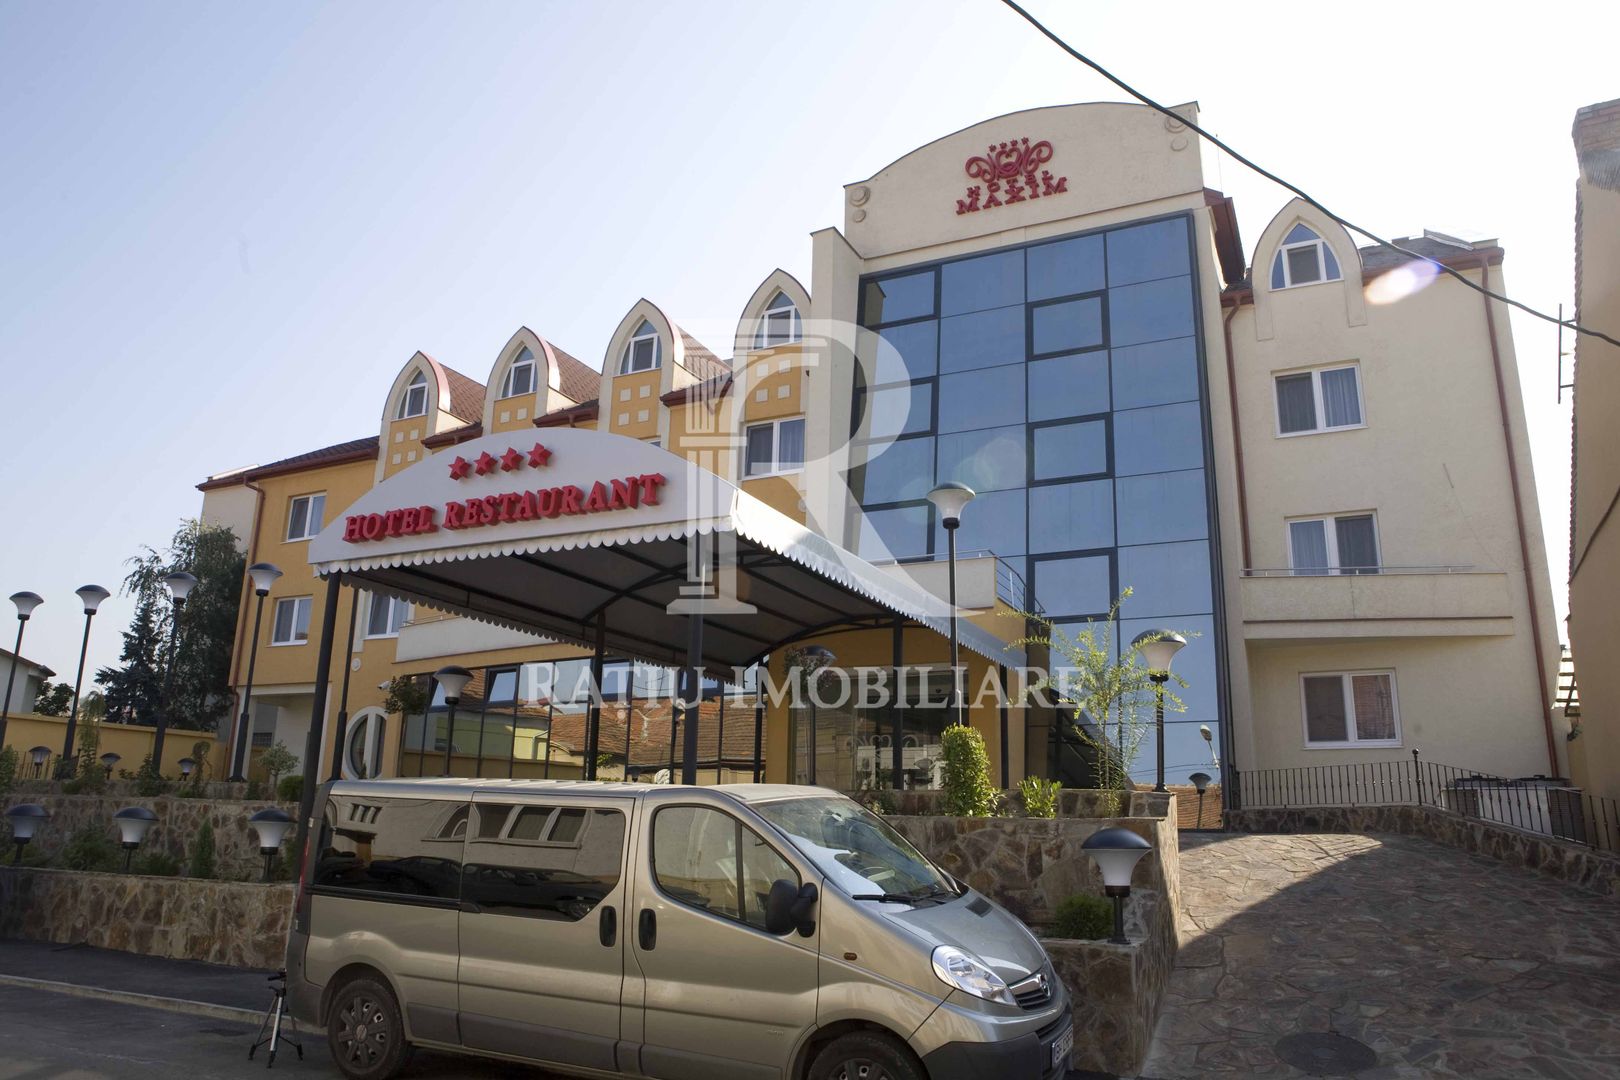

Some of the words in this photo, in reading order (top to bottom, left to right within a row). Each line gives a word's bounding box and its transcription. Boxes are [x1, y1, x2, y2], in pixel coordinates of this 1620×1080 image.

[956, 177, 1068, 216] MAXIM
[342, 505, 438, 543] HOTEL
[442, 472, 667, 530] RESTAURANT
